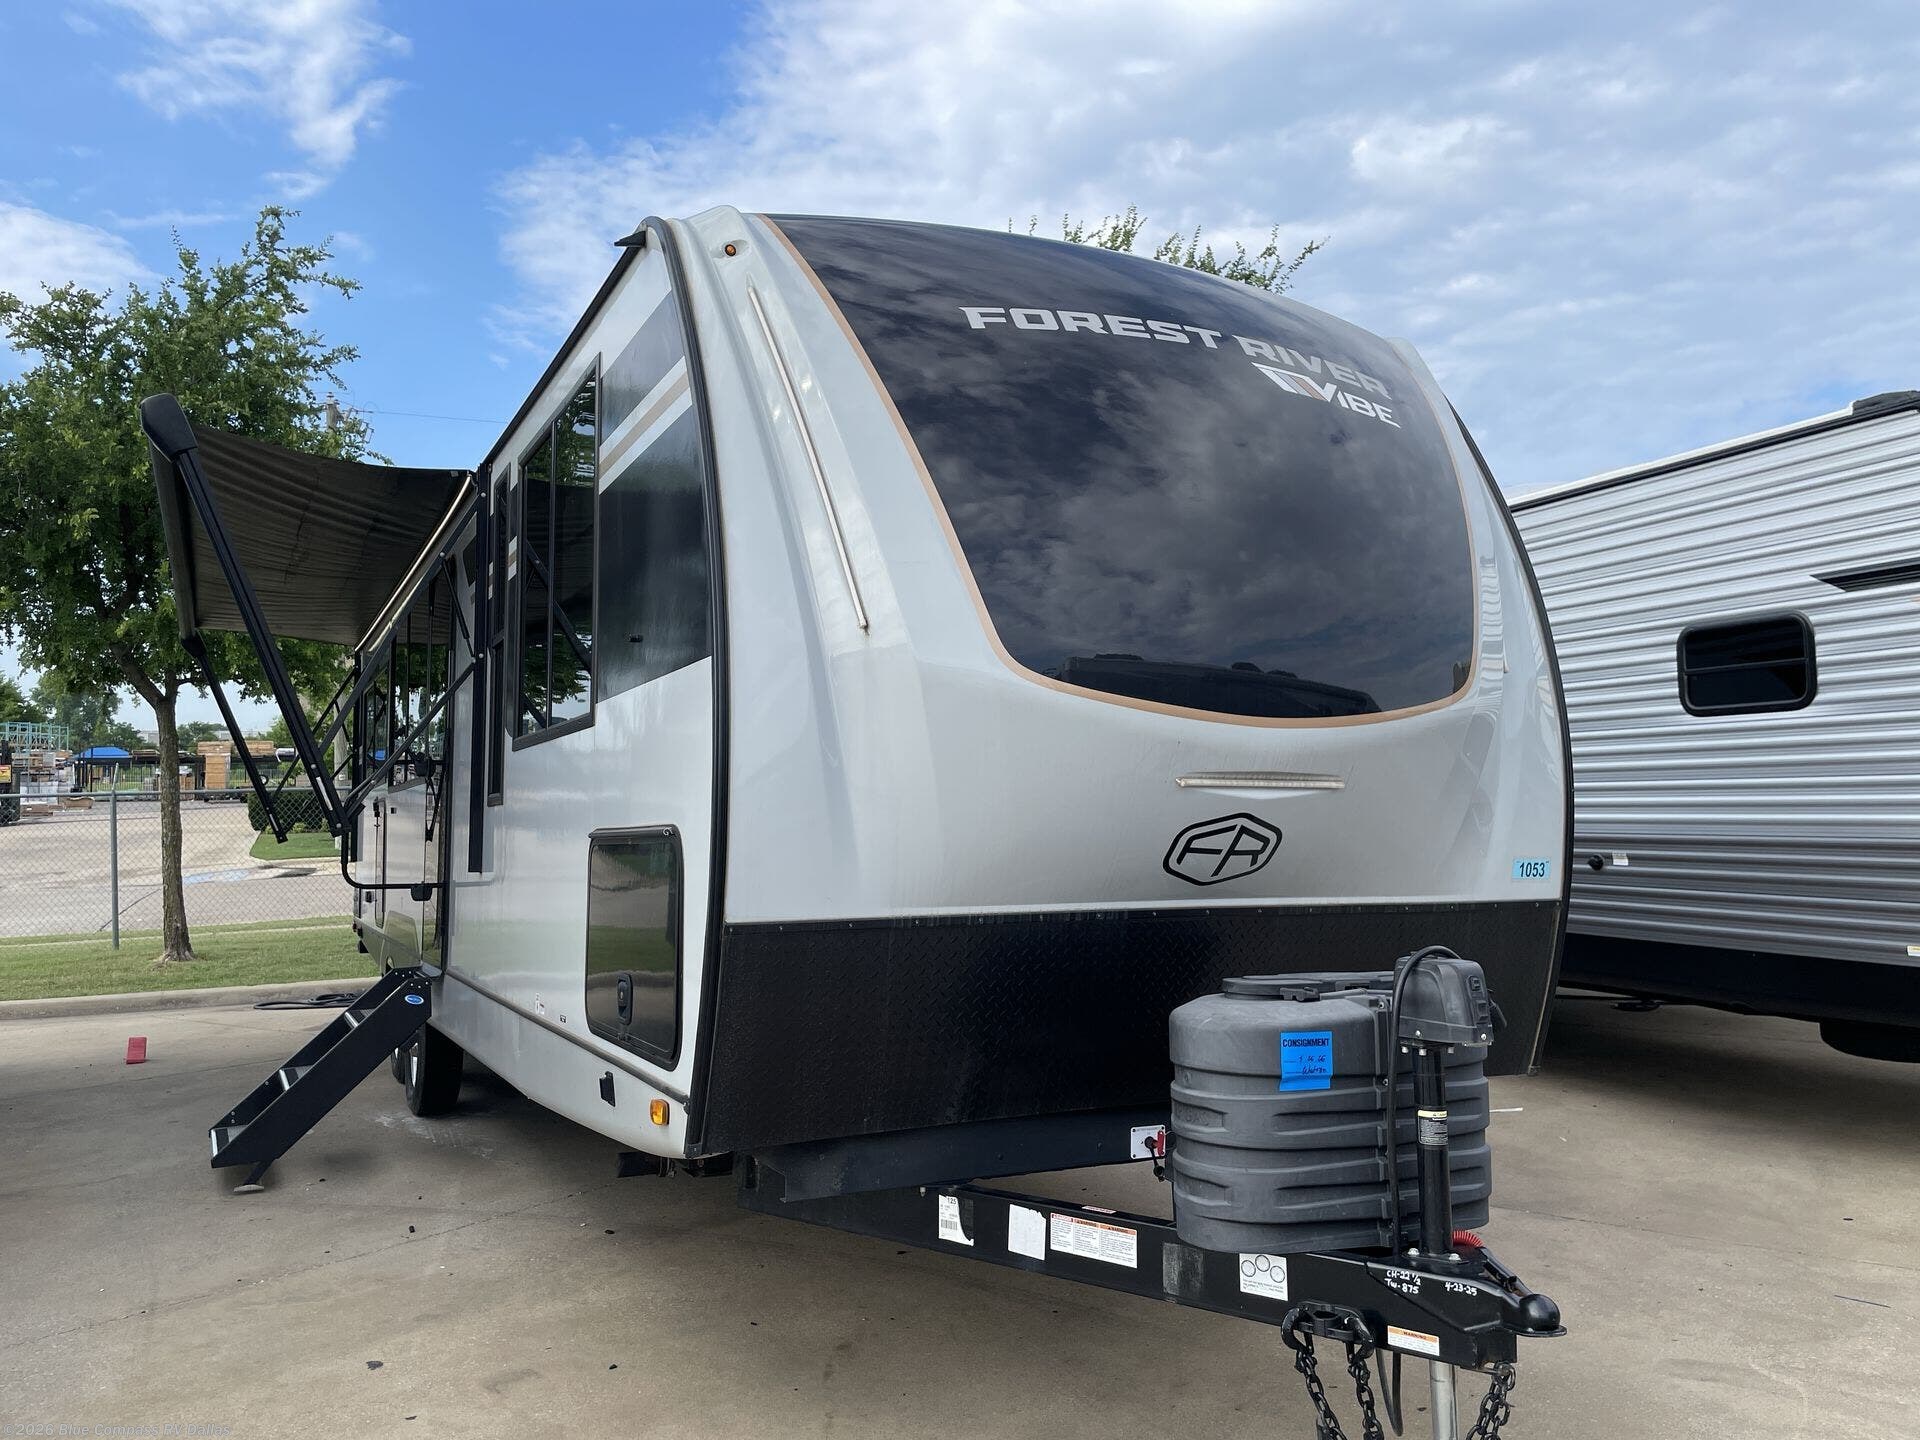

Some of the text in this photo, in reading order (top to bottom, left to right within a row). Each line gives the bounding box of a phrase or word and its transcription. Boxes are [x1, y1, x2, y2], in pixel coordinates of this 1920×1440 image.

[959, 307, 1393, 401] FOREST RIVER
[1519, 862, 1545, 877] 1053
[1282, 1038, 1329, 1048] CONSIGNMENT
[1386, 1269, 1410, 1281] CH-22
[1444, 1281, 1478, 1297] 4-23-25
